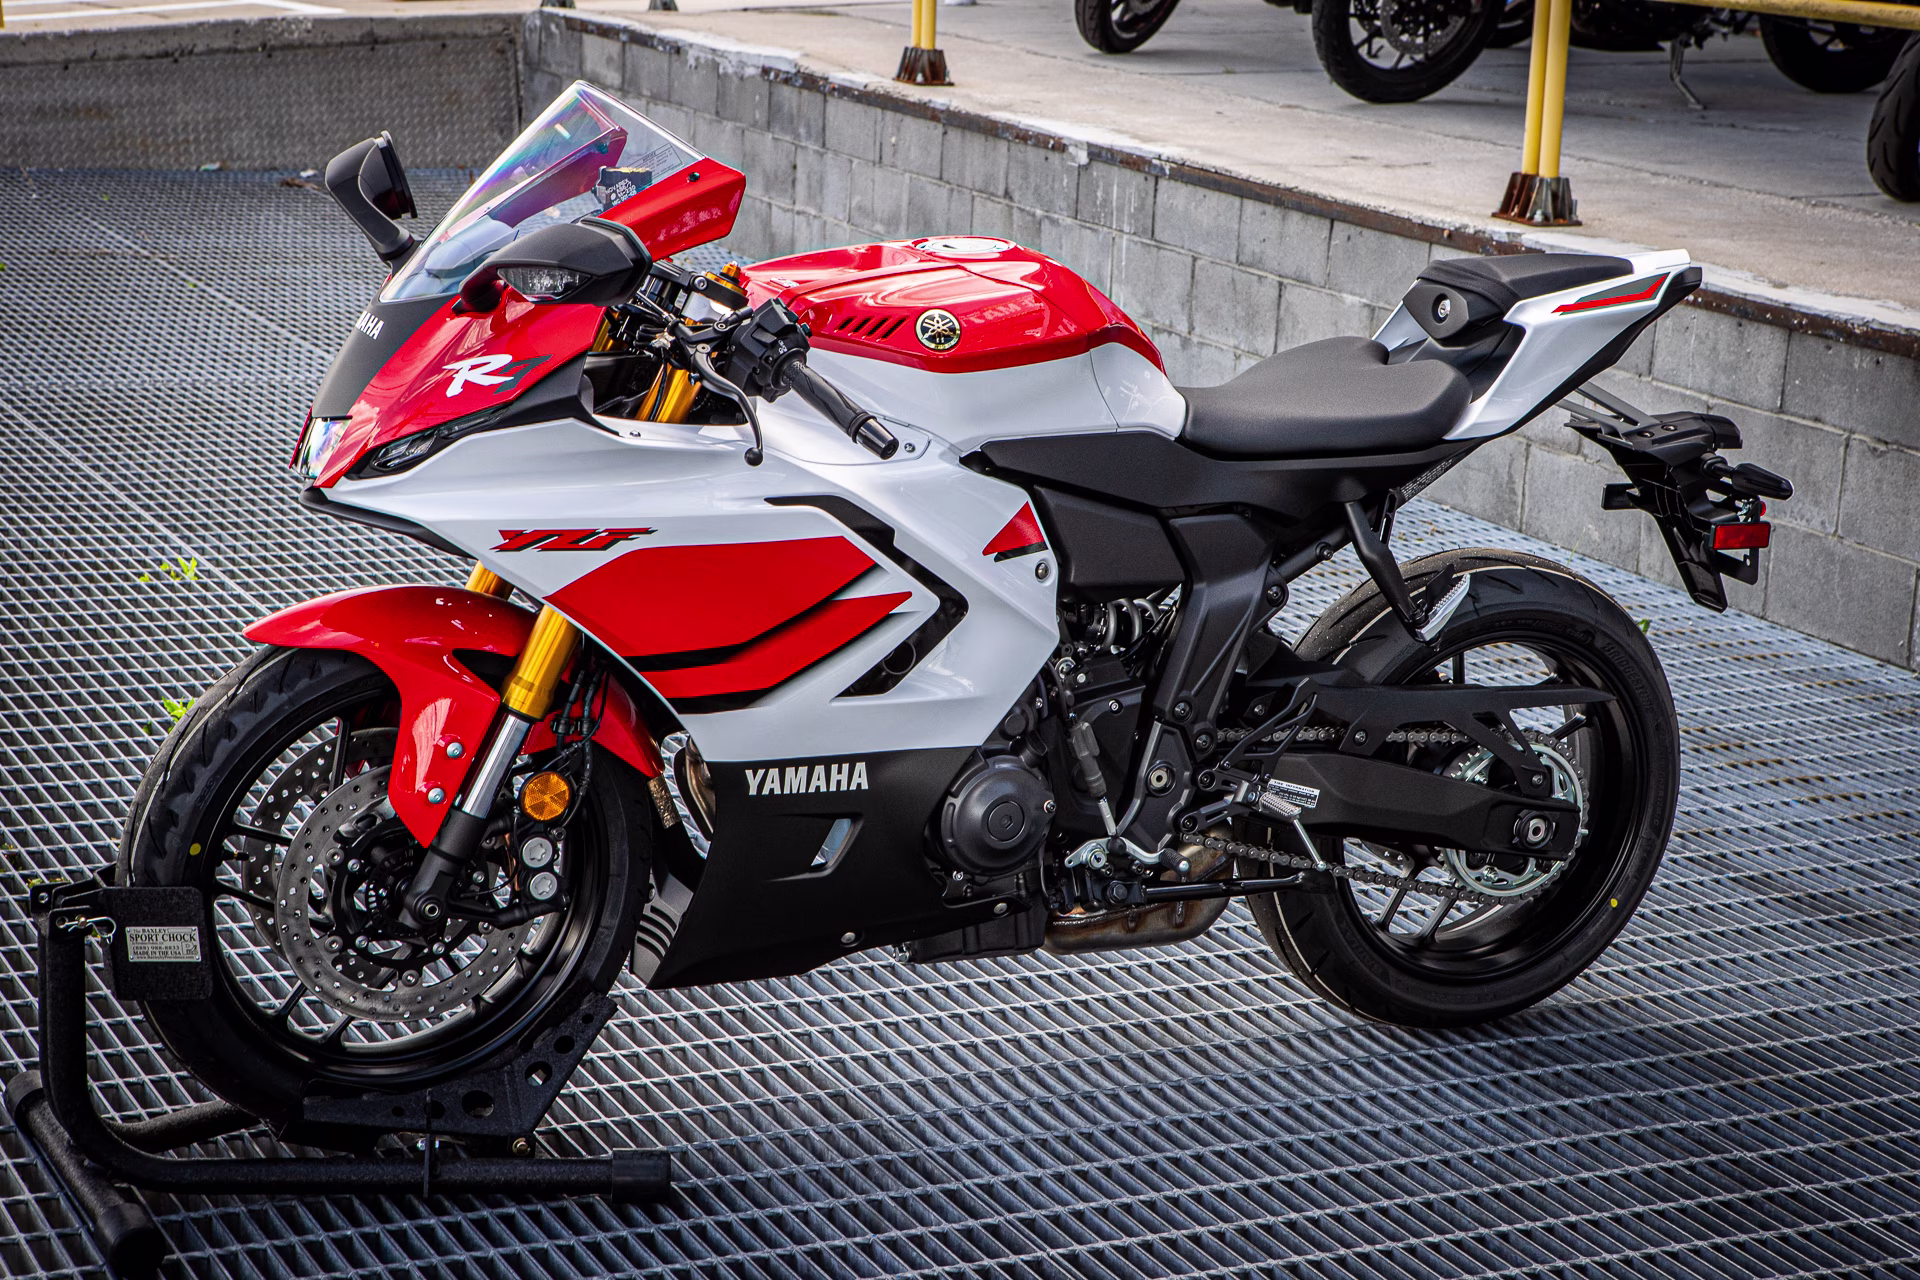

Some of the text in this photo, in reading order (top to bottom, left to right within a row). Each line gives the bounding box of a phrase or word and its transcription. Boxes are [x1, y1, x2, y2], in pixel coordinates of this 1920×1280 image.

[489, 527, 658, 553] YZF
[744, 761, 869, 796] YAMAHA
[129, 933, 196, 942] SPORT CHOCK
